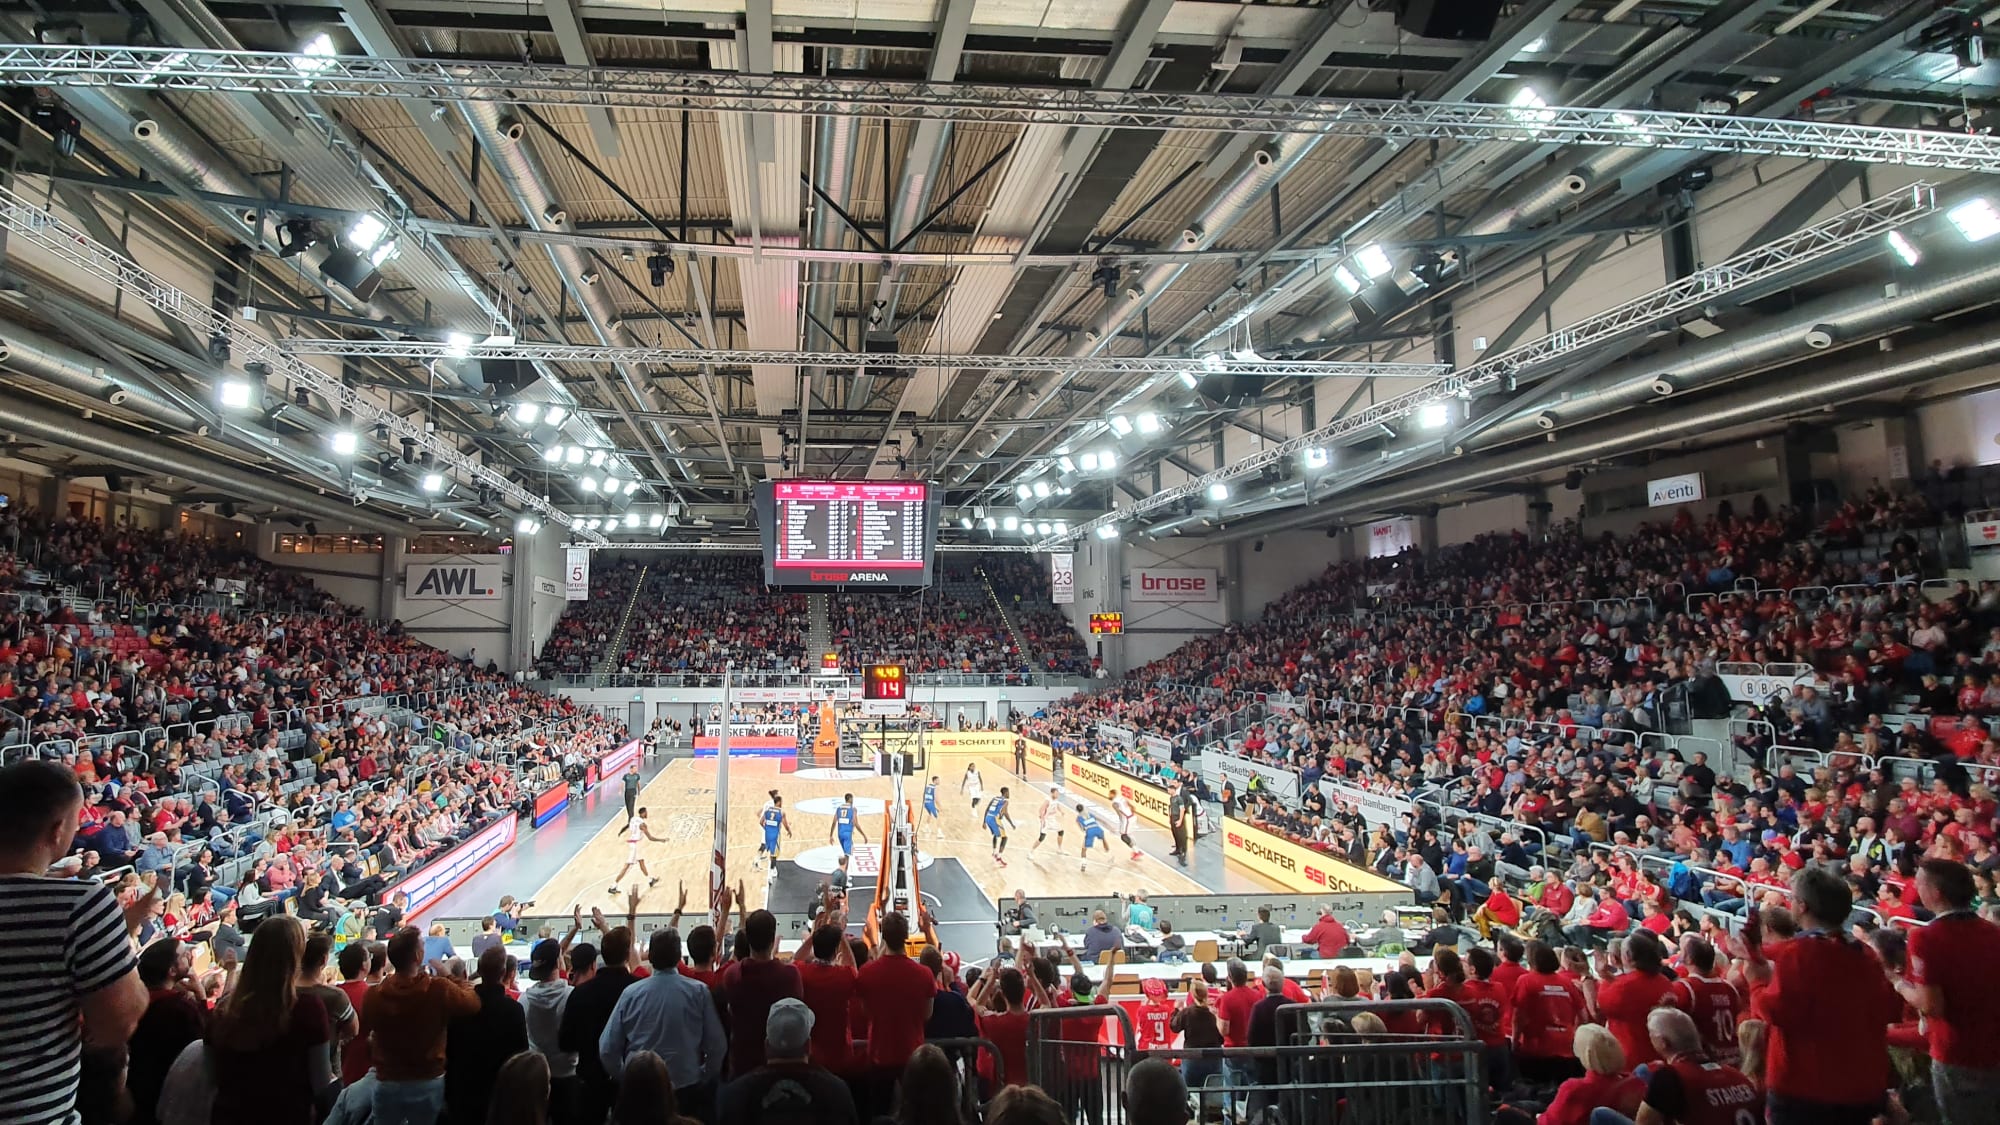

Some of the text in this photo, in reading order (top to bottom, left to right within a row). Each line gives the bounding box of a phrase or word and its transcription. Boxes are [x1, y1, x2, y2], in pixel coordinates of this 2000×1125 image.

[1653, 484, 1694, 502] Aventi
[572, 566, 583, 582] 5
[849, 572, 889, 582] ARENA
[1053, 571, 1073, 585] 23
[1141, 572, 1206, 591] brose
[882, 682, 899, 696] 14
[1304, 865, 1326, 887] SSI
[1154, 1021, 1165, 1042] 9
[1712, 1009, 1735, 1041] 10
